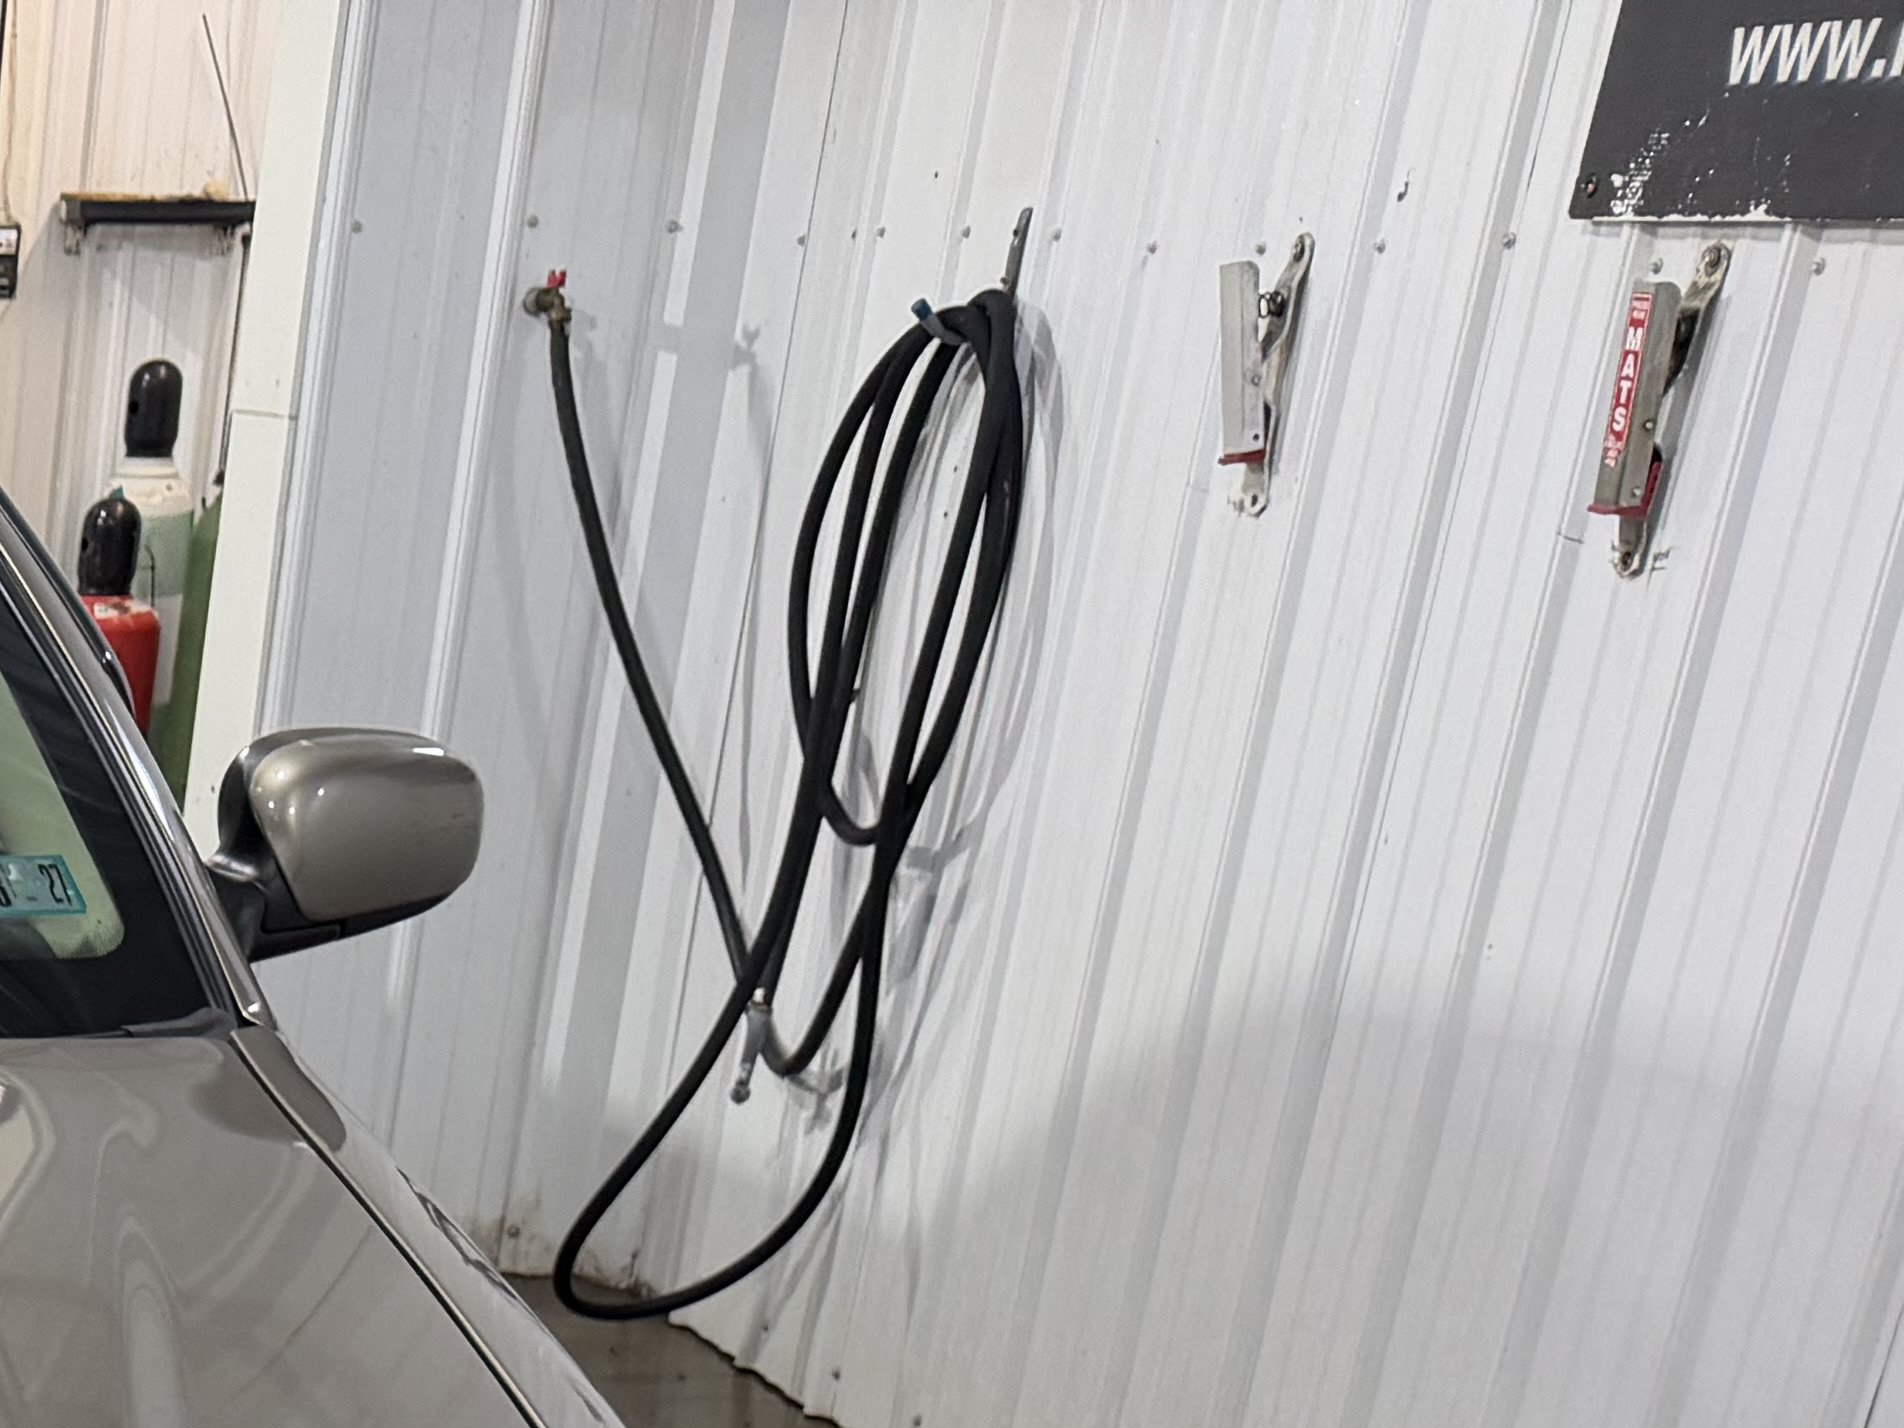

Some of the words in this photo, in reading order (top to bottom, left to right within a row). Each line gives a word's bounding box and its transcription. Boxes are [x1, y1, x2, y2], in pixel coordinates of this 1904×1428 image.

[1728, 17, 1904, 86] WWW.
[1612, 326, 1644, 433] MATS
[37, 863, 73, 907] 27
